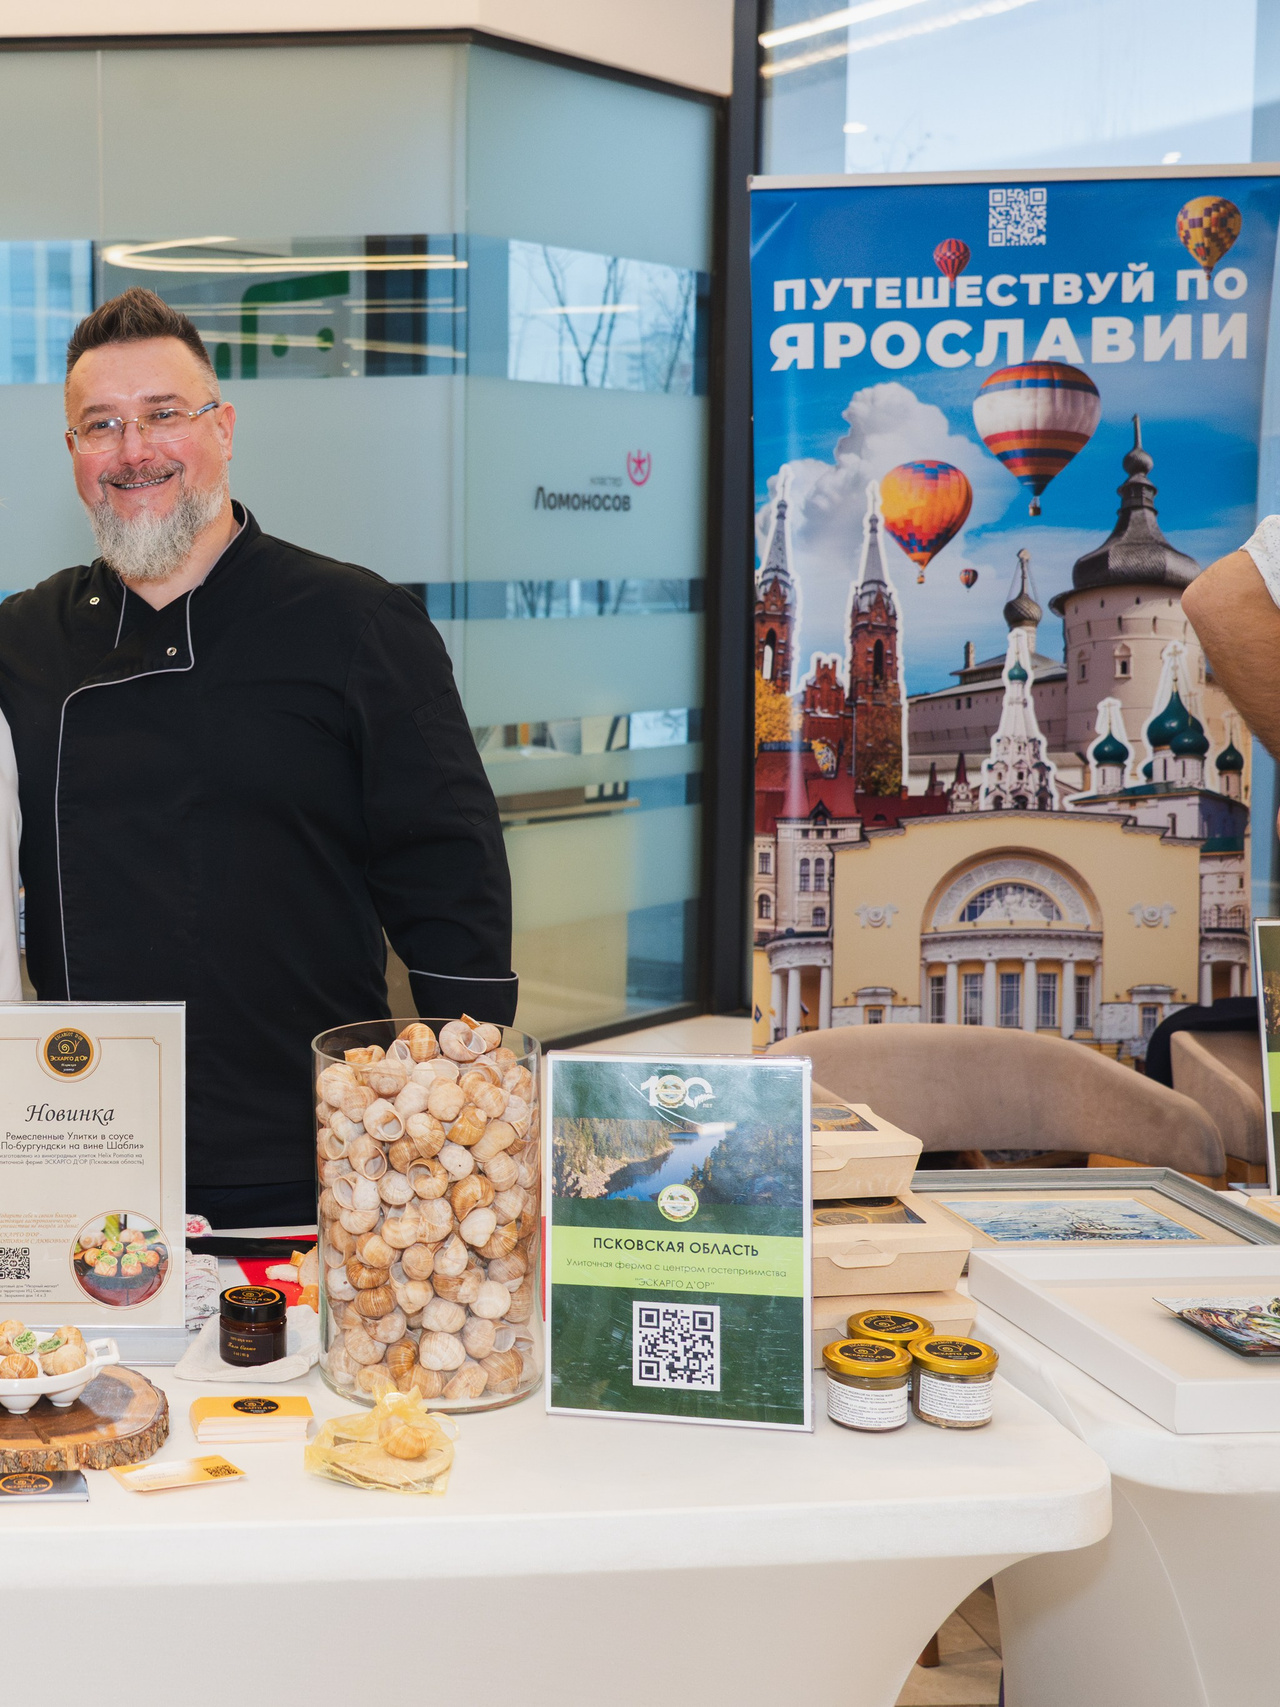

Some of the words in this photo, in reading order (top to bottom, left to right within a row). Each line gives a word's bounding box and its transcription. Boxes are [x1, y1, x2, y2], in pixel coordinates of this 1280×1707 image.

[773, 263, 1155, 311] ПУТЕШЕСТВУЙ
[1176, 267, 1248, 301] ПО
[769, 313, 1248, 371] ЯРОСЛАВИИ
[534, 486, 631, 512] Ломоносов
[25, 1103, 115, 1126] Новинка
[5, 1132, 64, 1141] Ремесленные
[67, 1132, 98, 1141] Улитки
[108, 1134, 134, 1143] соусе
[106, 1142, 144, 1151] Шабли»
[593, 1237, 684, 1253] ПСКОВСКАЯ
[689, 1242, 759, 1257] ОБЛАСТЬ
[566, 1258, 612, 1269] Улиточная
[614, 1261, 652, 1272] ферма
[662, 1265, 705, 1275] центром
[707, 1267, 787, 1279] гостеприимства
[634, 1277, 683, 1289] "ЭСКАРГО
